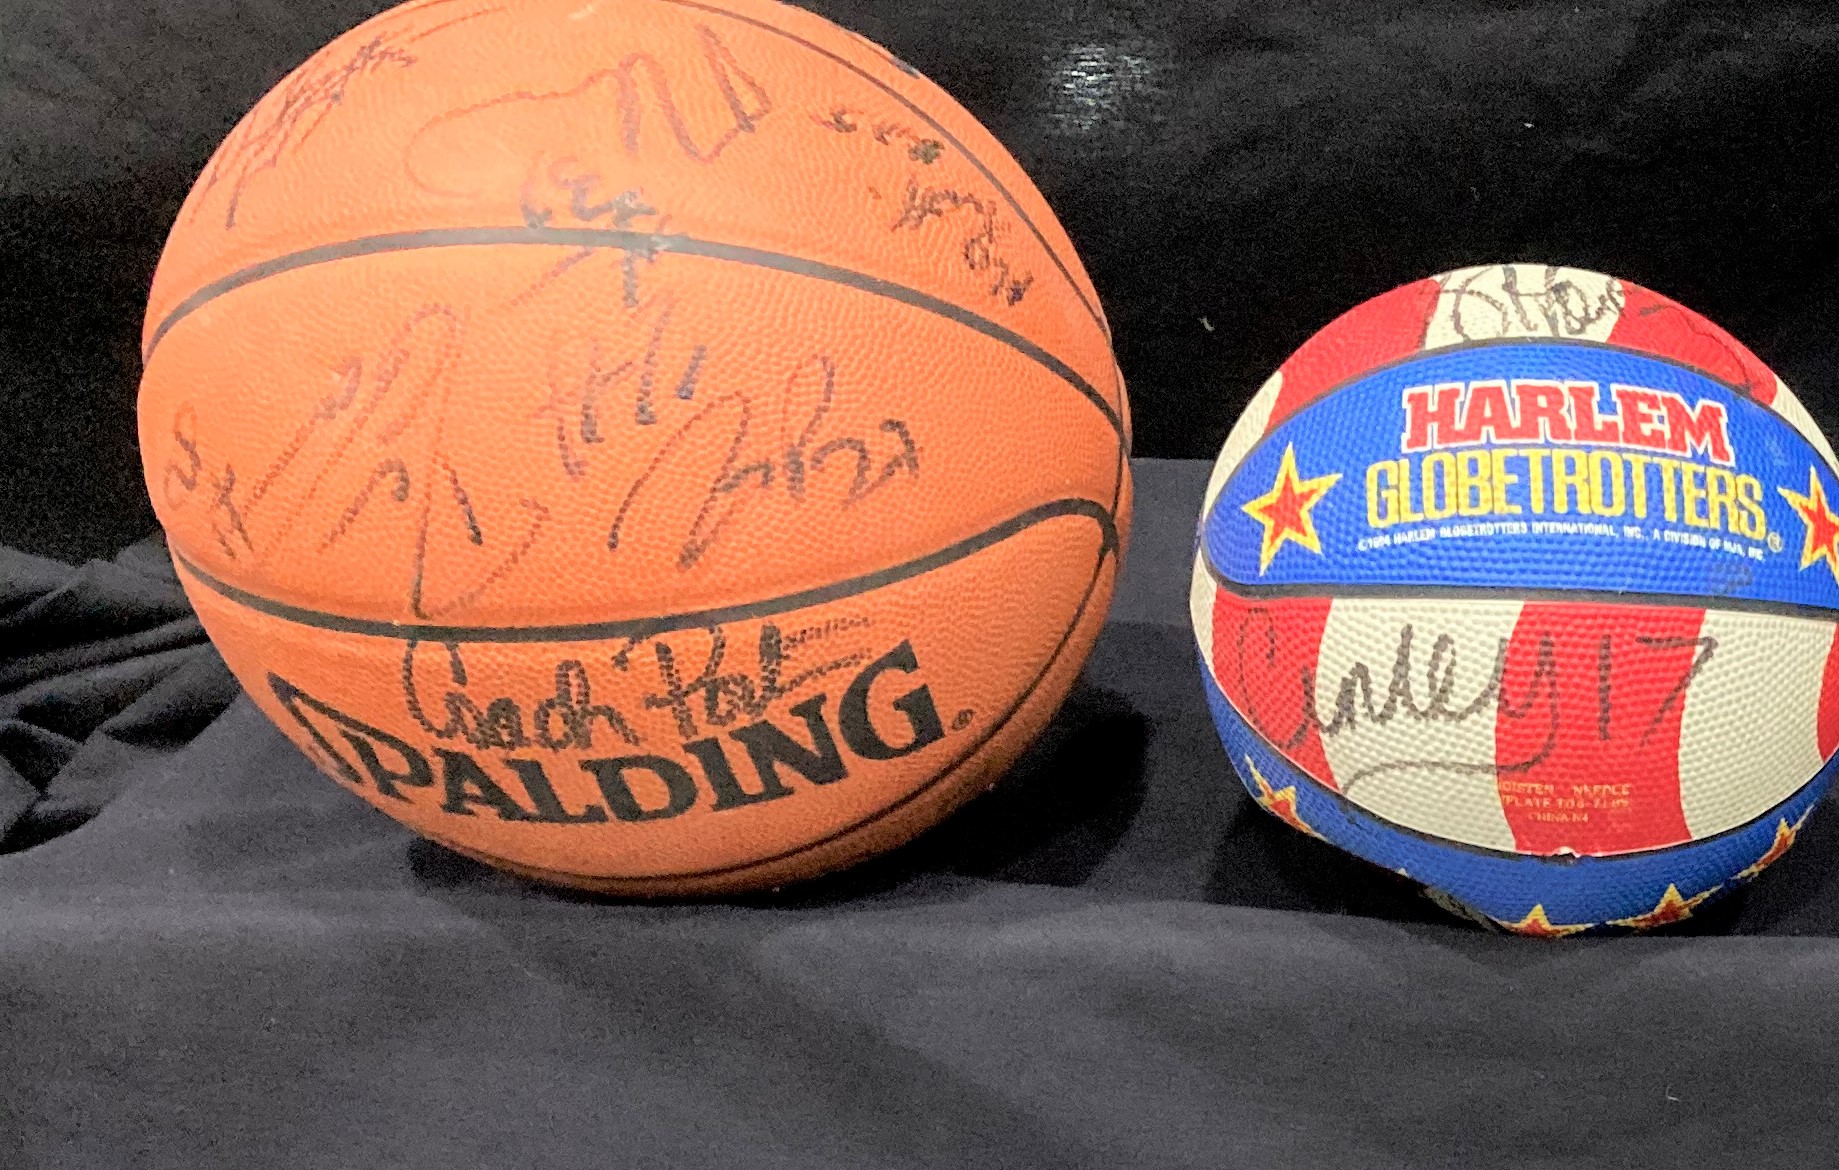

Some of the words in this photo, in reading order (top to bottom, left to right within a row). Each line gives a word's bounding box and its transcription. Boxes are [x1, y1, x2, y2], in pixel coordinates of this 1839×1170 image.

[1401, 378, 1736, 467] HARLEM
[1365, 447, 1766, 545] GLOBETROTTERS
[1393, 528, 1436, 545] HARLEM
[1440, 522, 1528, 539] GLOBETROTTERS
[266, 638, 946, 824] SPALDING
